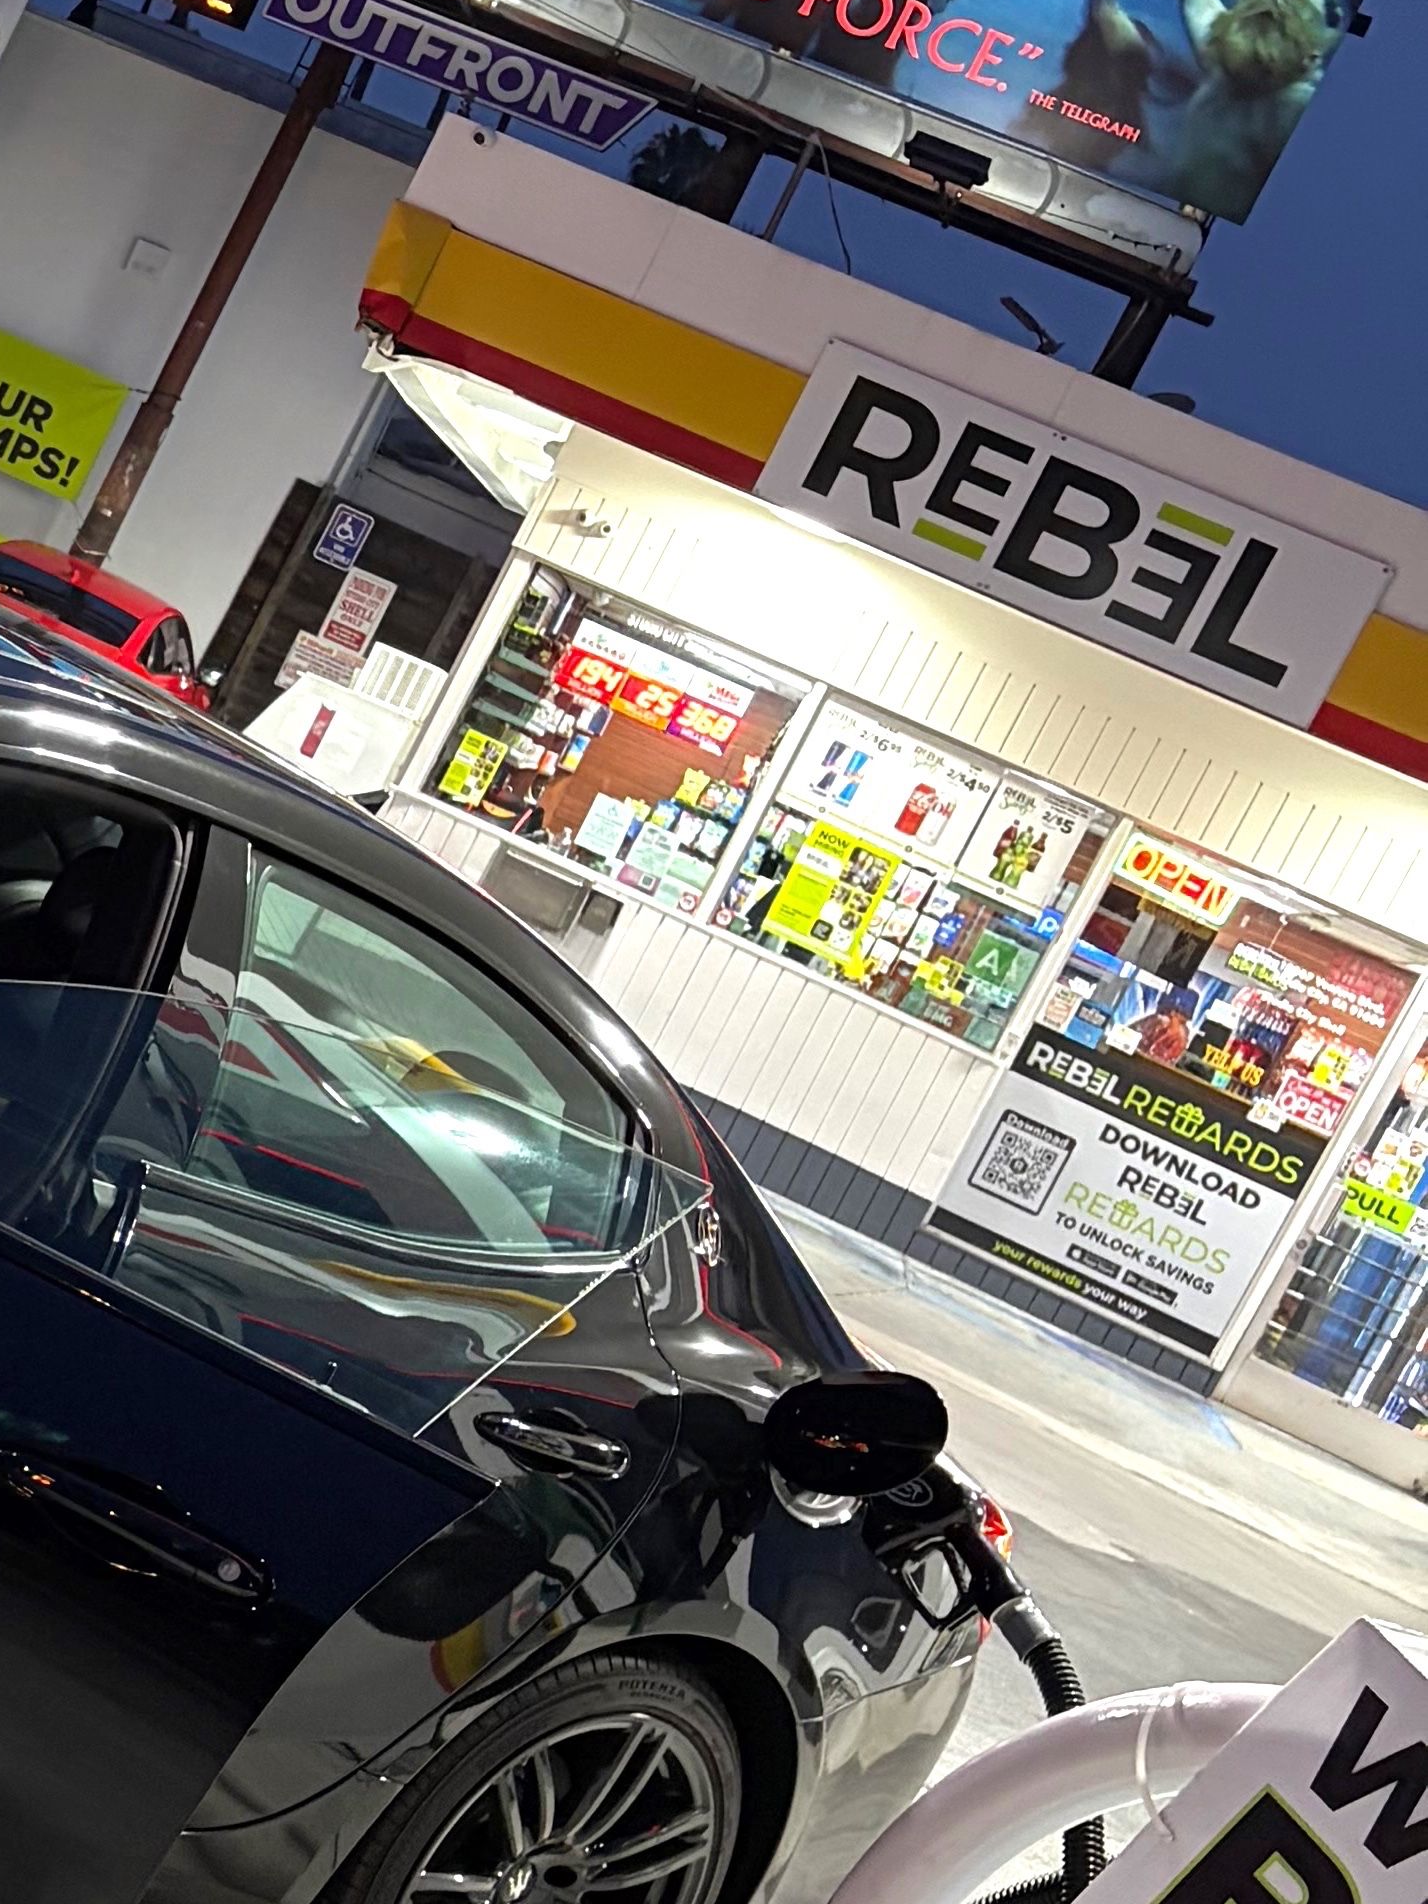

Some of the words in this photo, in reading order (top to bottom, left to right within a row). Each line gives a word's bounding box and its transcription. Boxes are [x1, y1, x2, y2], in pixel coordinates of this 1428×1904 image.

[1028, 87, 1059, 114] THE
[1059, 98, 1142, 144] TELEGRAPH
[802, 374, 1288, 689] REBEL
[340, 599, 374, 623] SHELL
[572, 656, 623, 693] 194
[635, 684, 679, 718] 25
[675, 702, 739, 742] 368
[818, 830, 850, 849] NOW
[1041, 810, 1076, 834] 2/$5
[1126, 846, 1232, 918] OPEN
[975, 948, 1000, 976] A
[1026, 1041, 1122, 1105] REBEL
[1202, 1043, 1240, 1078] YELP
[1240, 1060, 1265, 1088] US
[1006, 1112, 1070, 1149] Download
[1278, 1095, 1339, 1130] OPEN
[1099, 1123, 1261, 1210] DOWNLOAD
[1117, 1166, 1207, 1226] REBEL
[1056, 1211, 1077, 1229] TO
[1078, 1223, 1144, 1263] UNLOCK
[1145, 1253, 1214, 1296] SAVINGS
[992, 1239, 1025, 1262] your
[1026, 1254, 1082, 1289] rewards
[1081, 1277, 1115, 1306] your
[1116, 1295, 1148, 1321] way
[618, 1680, 685, 1699] POTENZA
